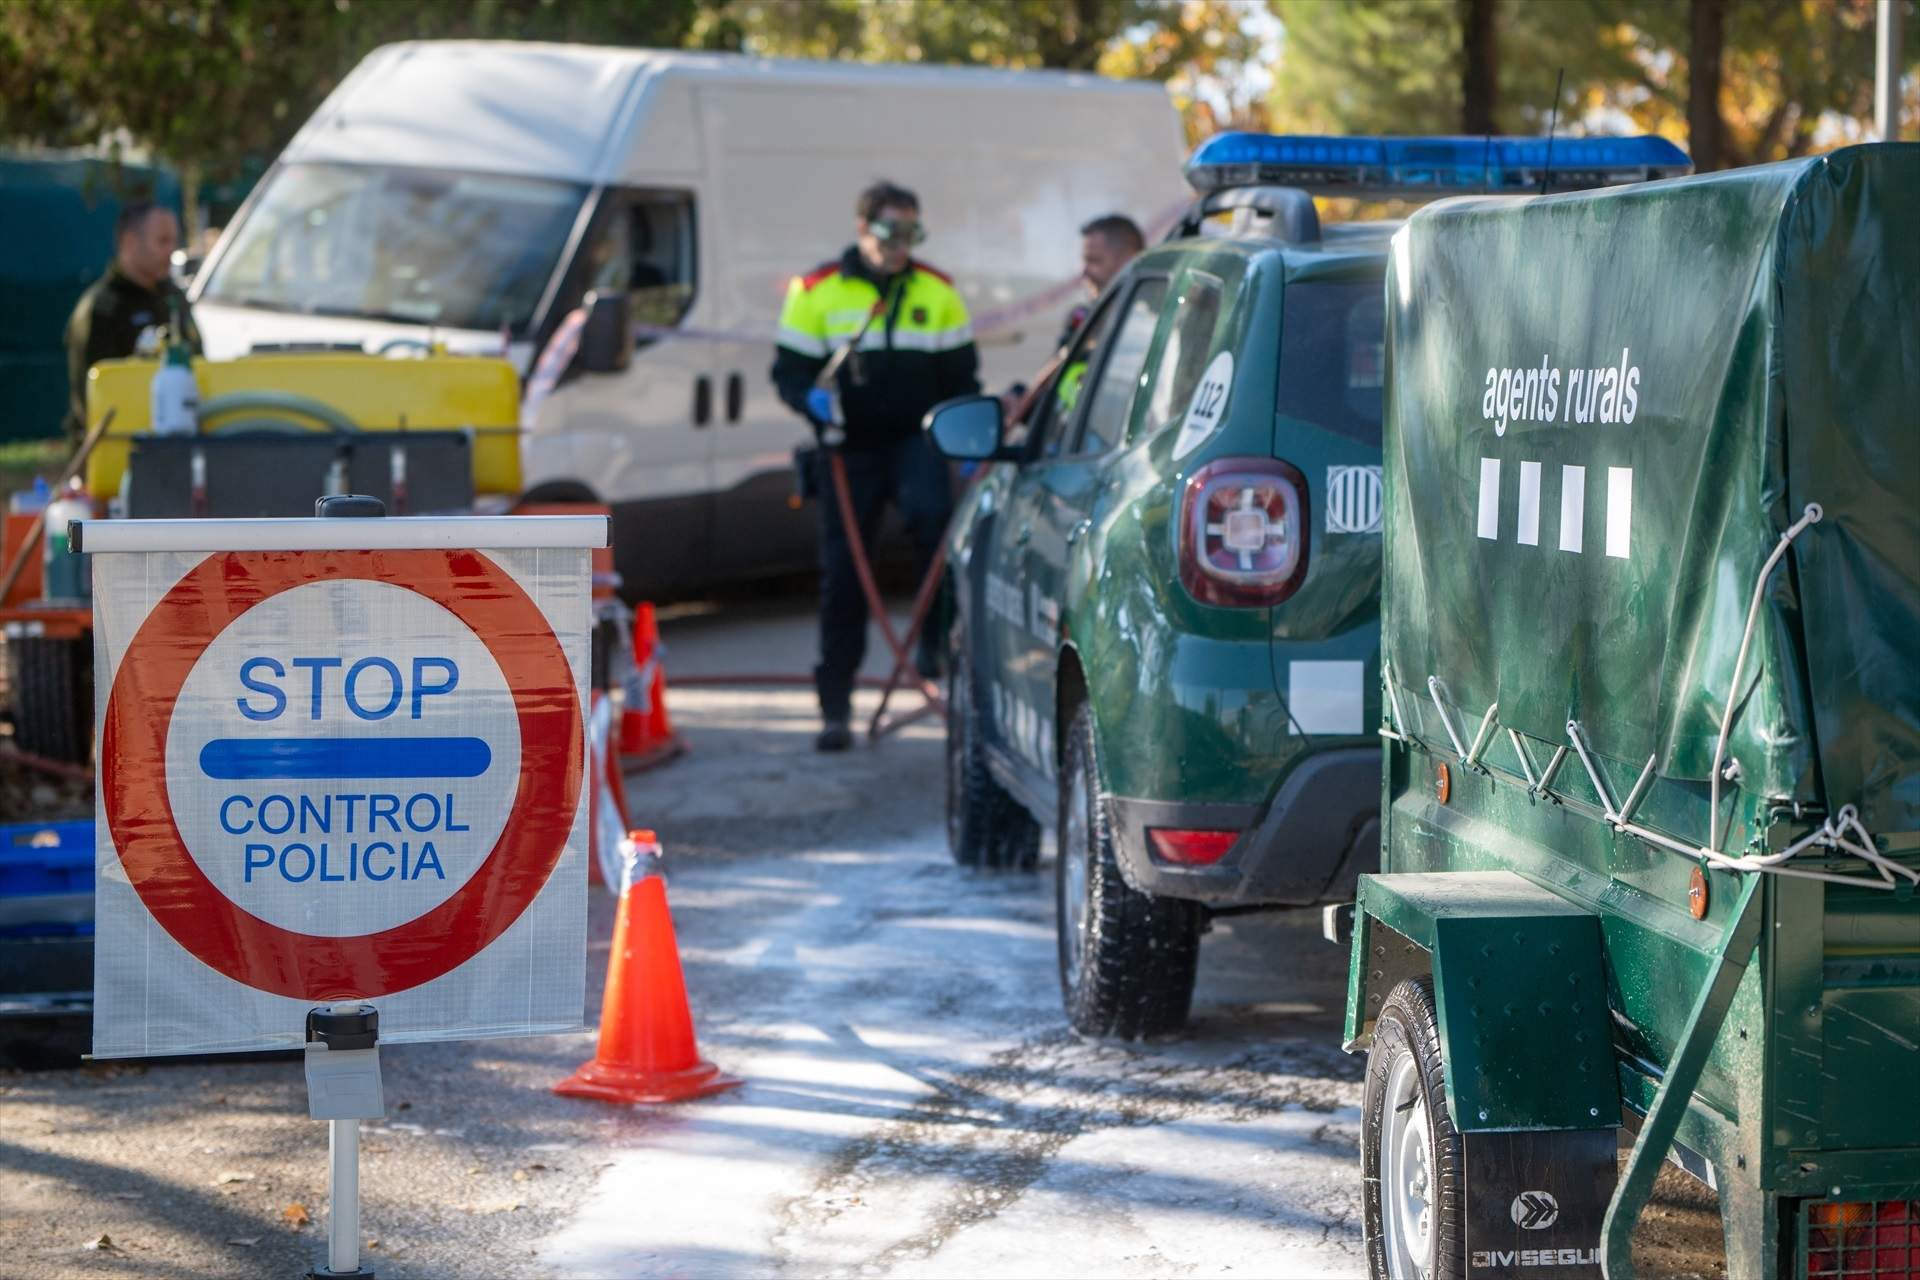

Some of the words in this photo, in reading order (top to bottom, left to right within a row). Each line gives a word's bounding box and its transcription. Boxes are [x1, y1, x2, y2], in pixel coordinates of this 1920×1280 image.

[1194, 381, 1224, 418] 112
[1482, 354, 1560, 437] agents
[1563, 347, 1640, 425] rurals
[236, 656, 460, 721] STOP
[218, 792, 471, 836] CONTROL
[243, 840, 446, 883] POLICIA
